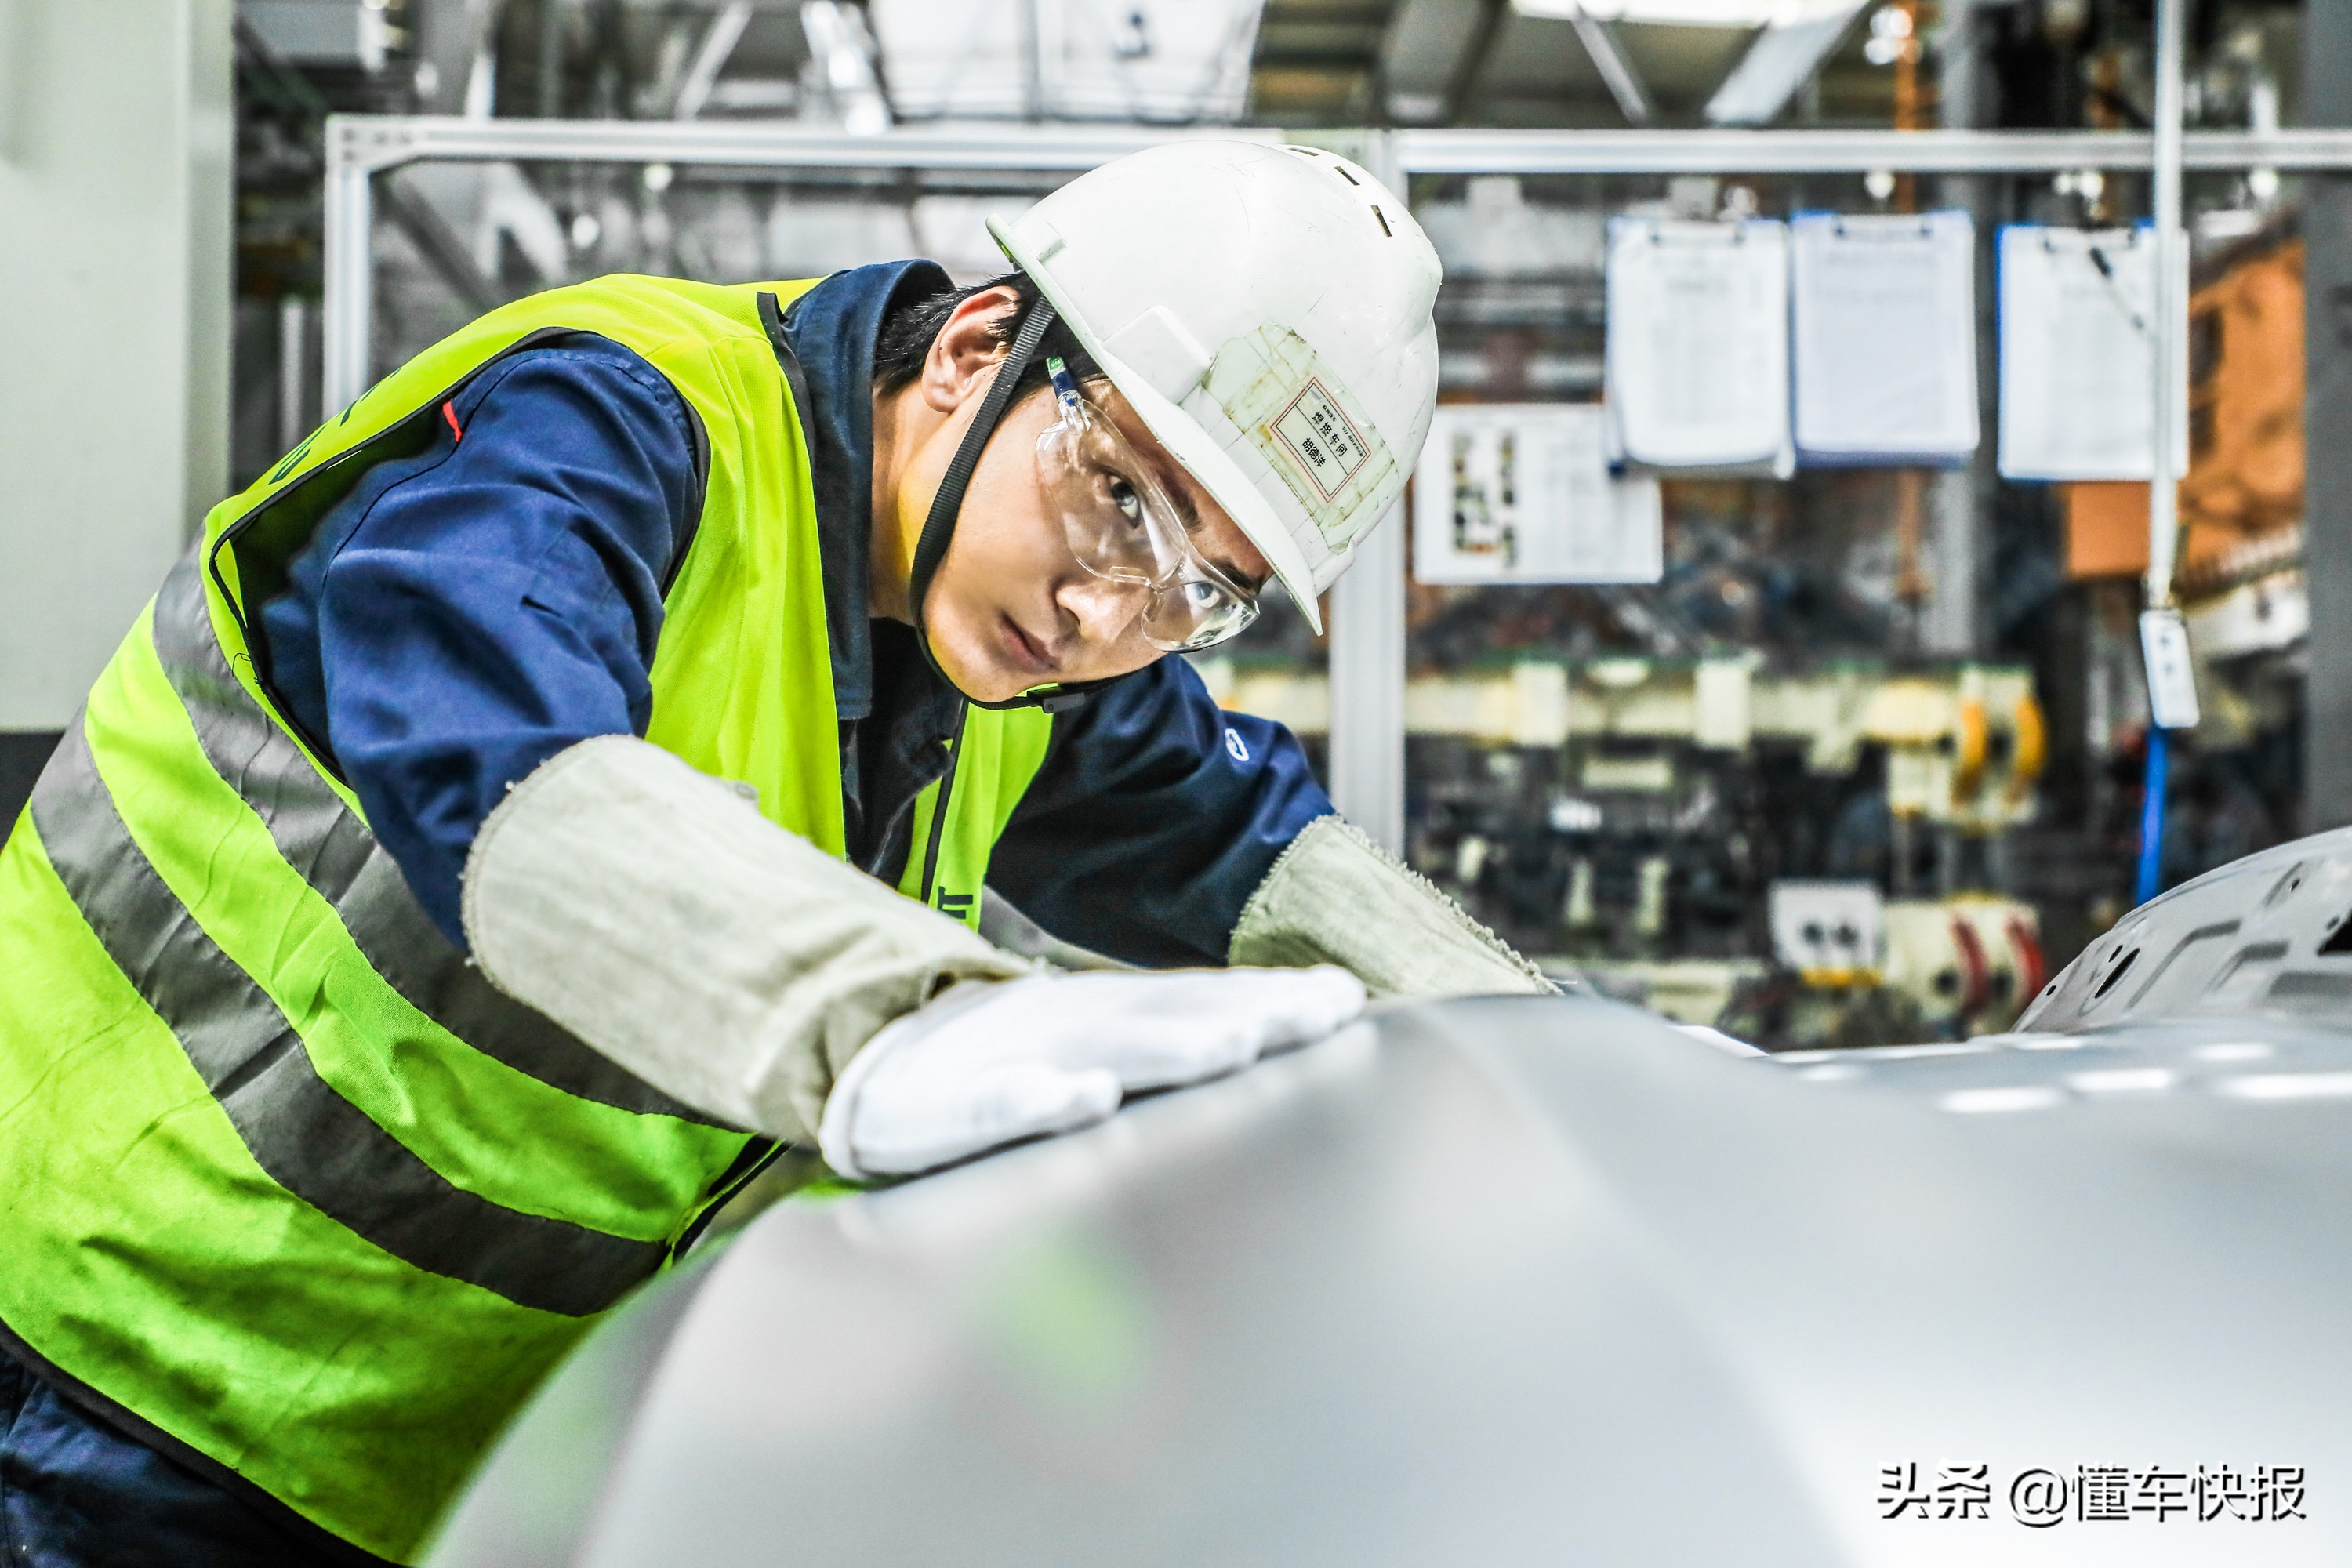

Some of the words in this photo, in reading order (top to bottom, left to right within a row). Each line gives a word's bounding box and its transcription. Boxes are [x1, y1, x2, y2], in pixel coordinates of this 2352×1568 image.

[1301, 437, 1327, 467] 胡德洋
[1312, 412, 1348, 457] 焊接车间
